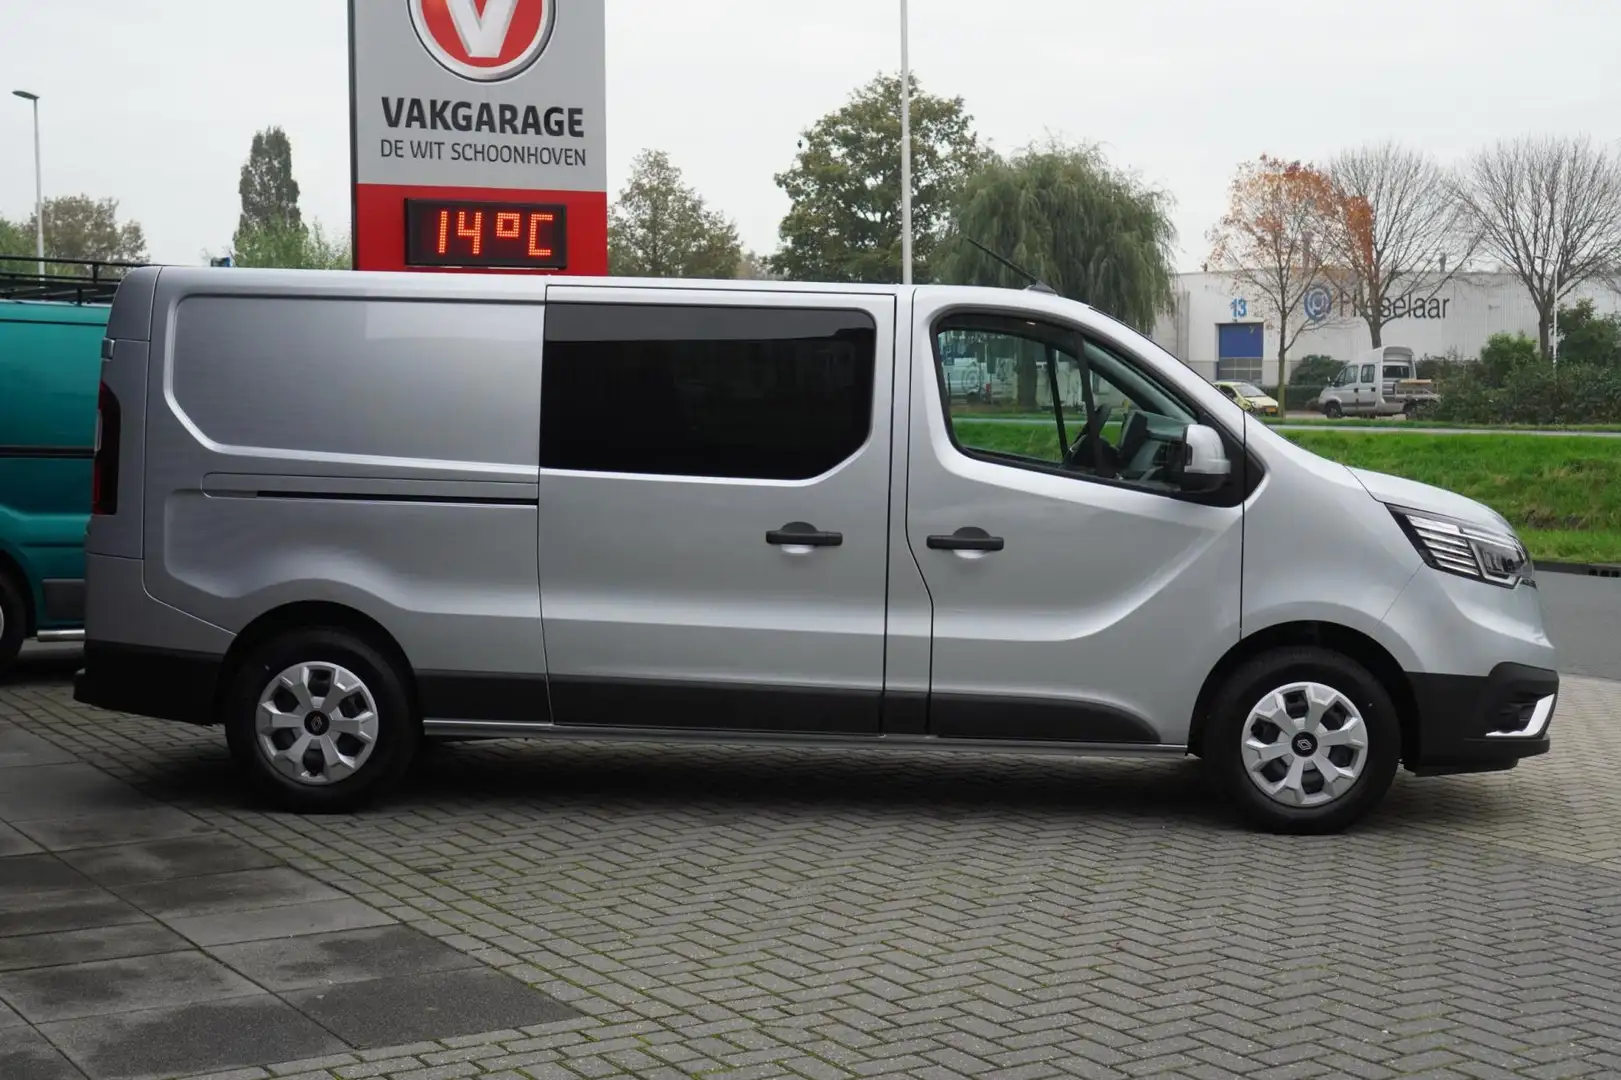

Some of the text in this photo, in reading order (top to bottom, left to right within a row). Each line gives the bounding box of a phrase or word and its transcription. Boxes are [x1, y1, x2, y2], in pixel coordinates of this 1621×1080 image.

[381, 96, 585, 138] VAKGARAGE
[380, 139, 586, 167] DE WIT SCHOONHOVEN
[1231, 297, 1247, 317] 13
